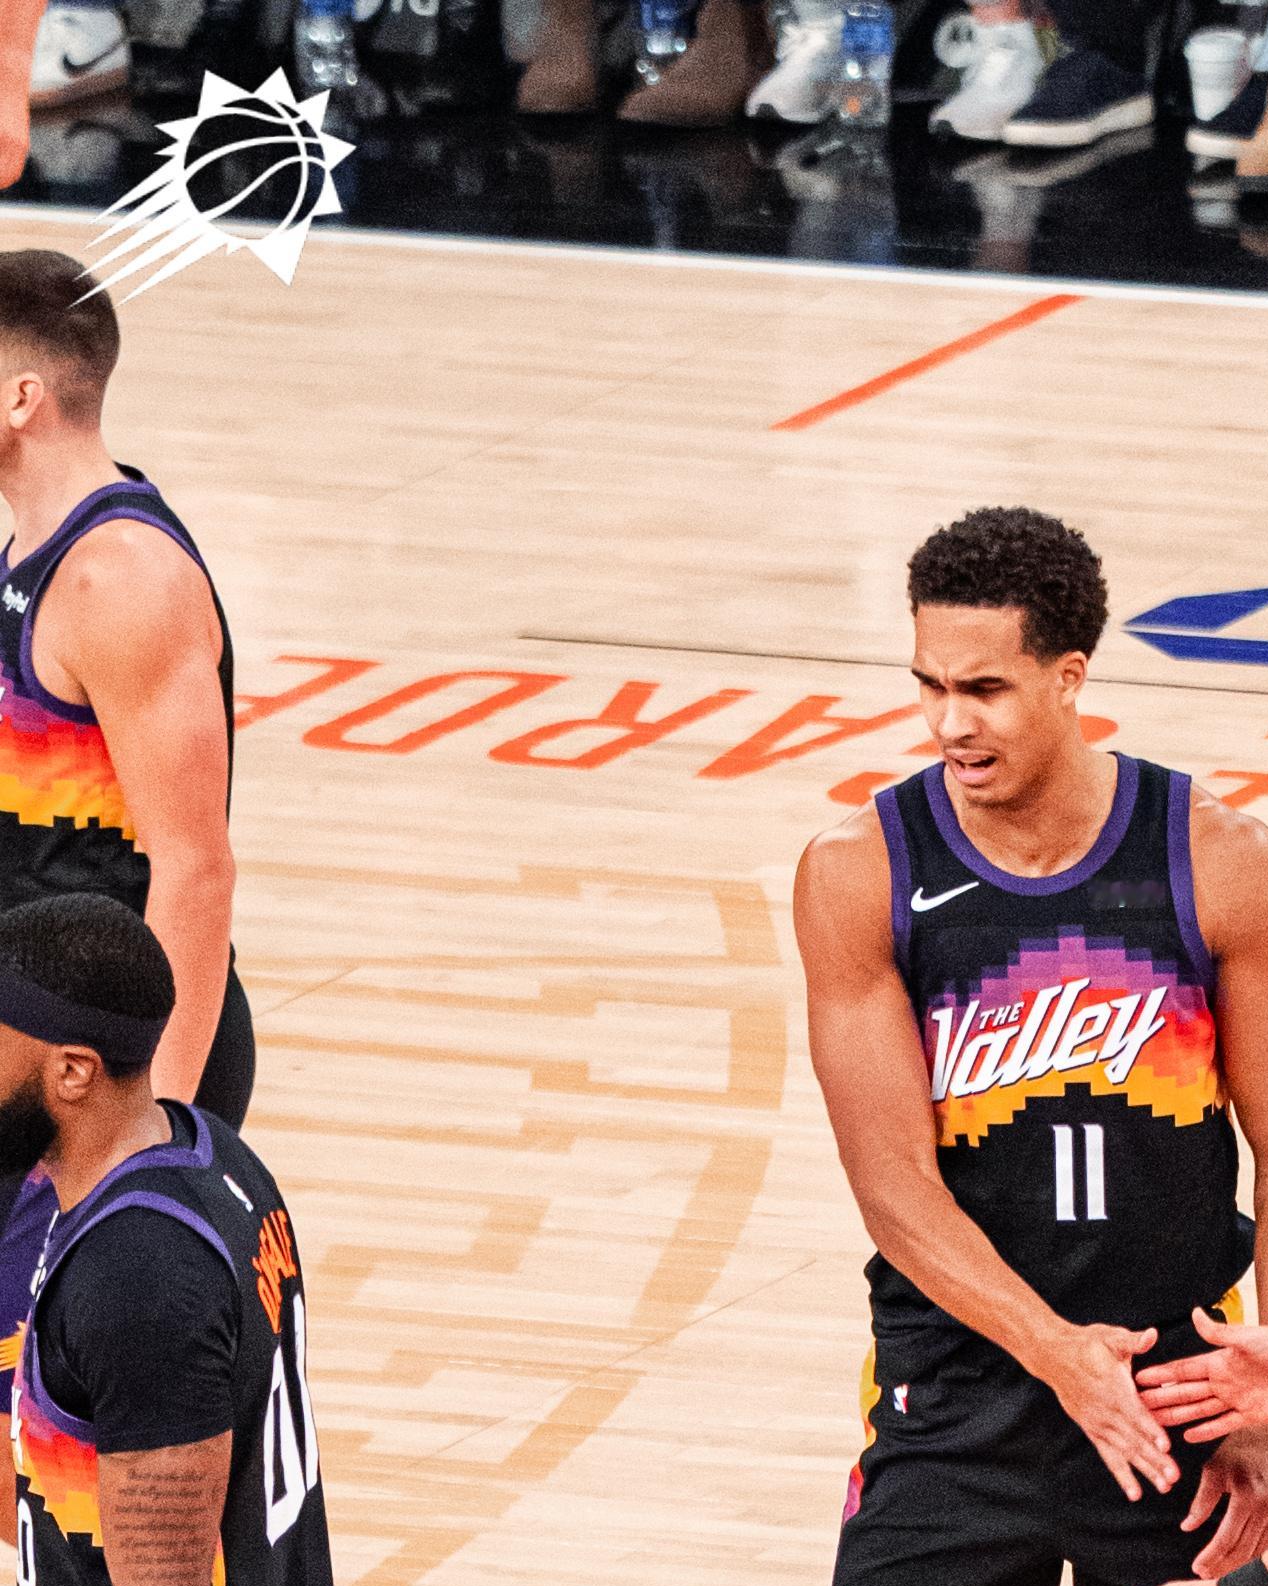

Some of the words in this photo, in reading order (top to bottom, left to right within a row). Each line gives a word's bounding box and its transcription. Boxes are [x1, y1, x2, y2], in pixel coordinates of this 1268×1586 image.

[931, 977, 1168, 1102] Valley
[979, 1000, 1025, 1031] THE
[1051, 1123, 1109, 1222] 11
